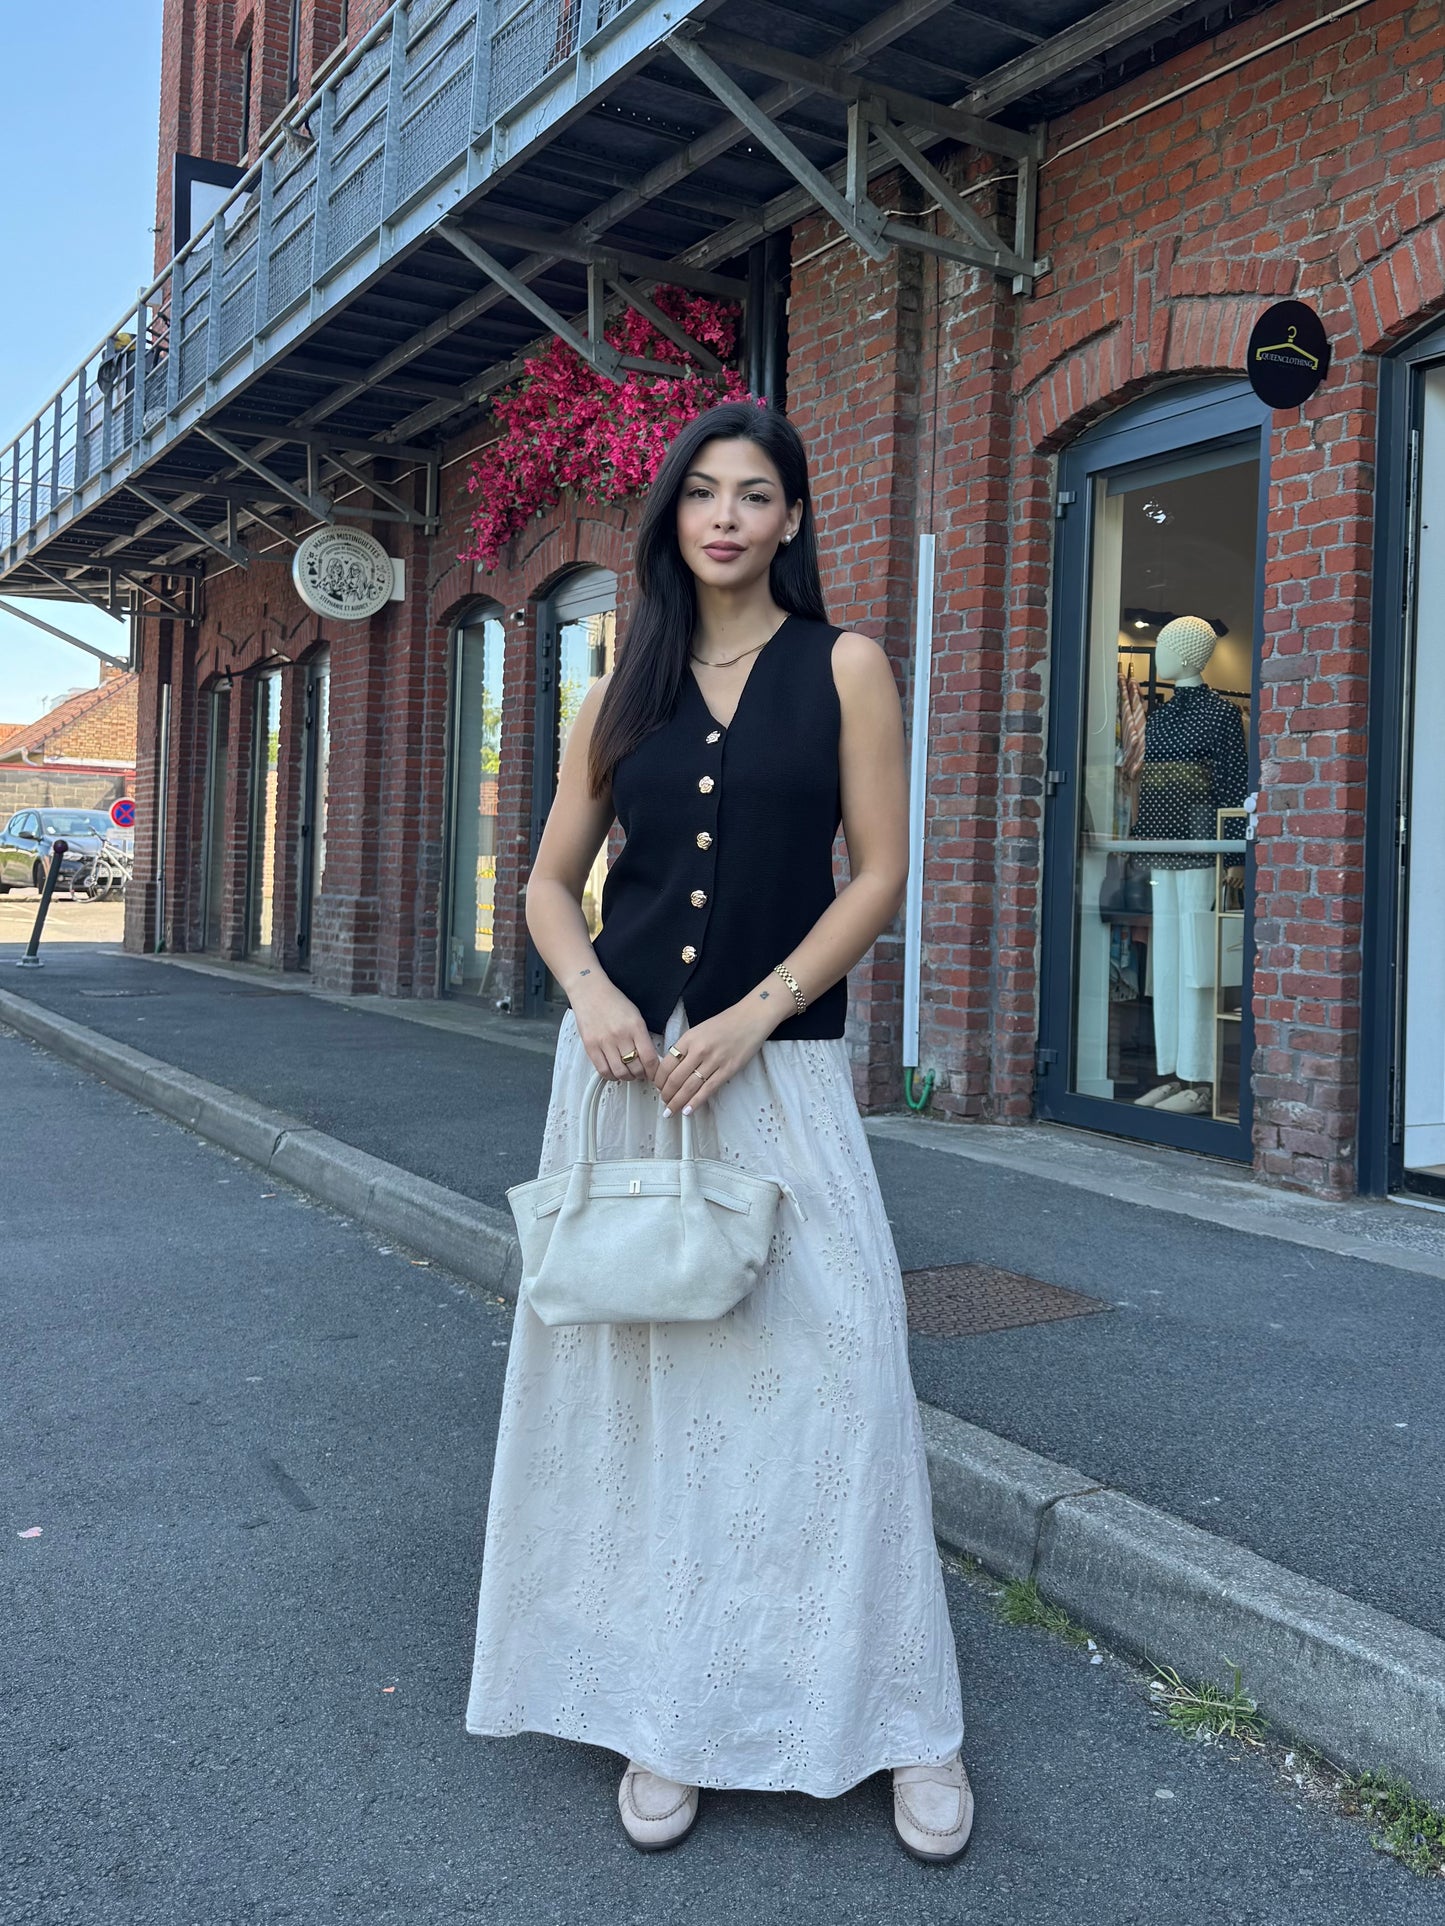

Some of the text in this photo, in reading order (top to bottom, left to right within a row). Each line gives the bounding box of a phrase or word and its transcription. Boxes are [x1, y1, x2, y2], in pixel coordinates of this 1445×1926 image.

[1261, 352, 1313, 367] QUEENCLOTHING
[313, 533, 336, 549] MAISON
[336, 533, 380, 558] MISTINGUETTES
